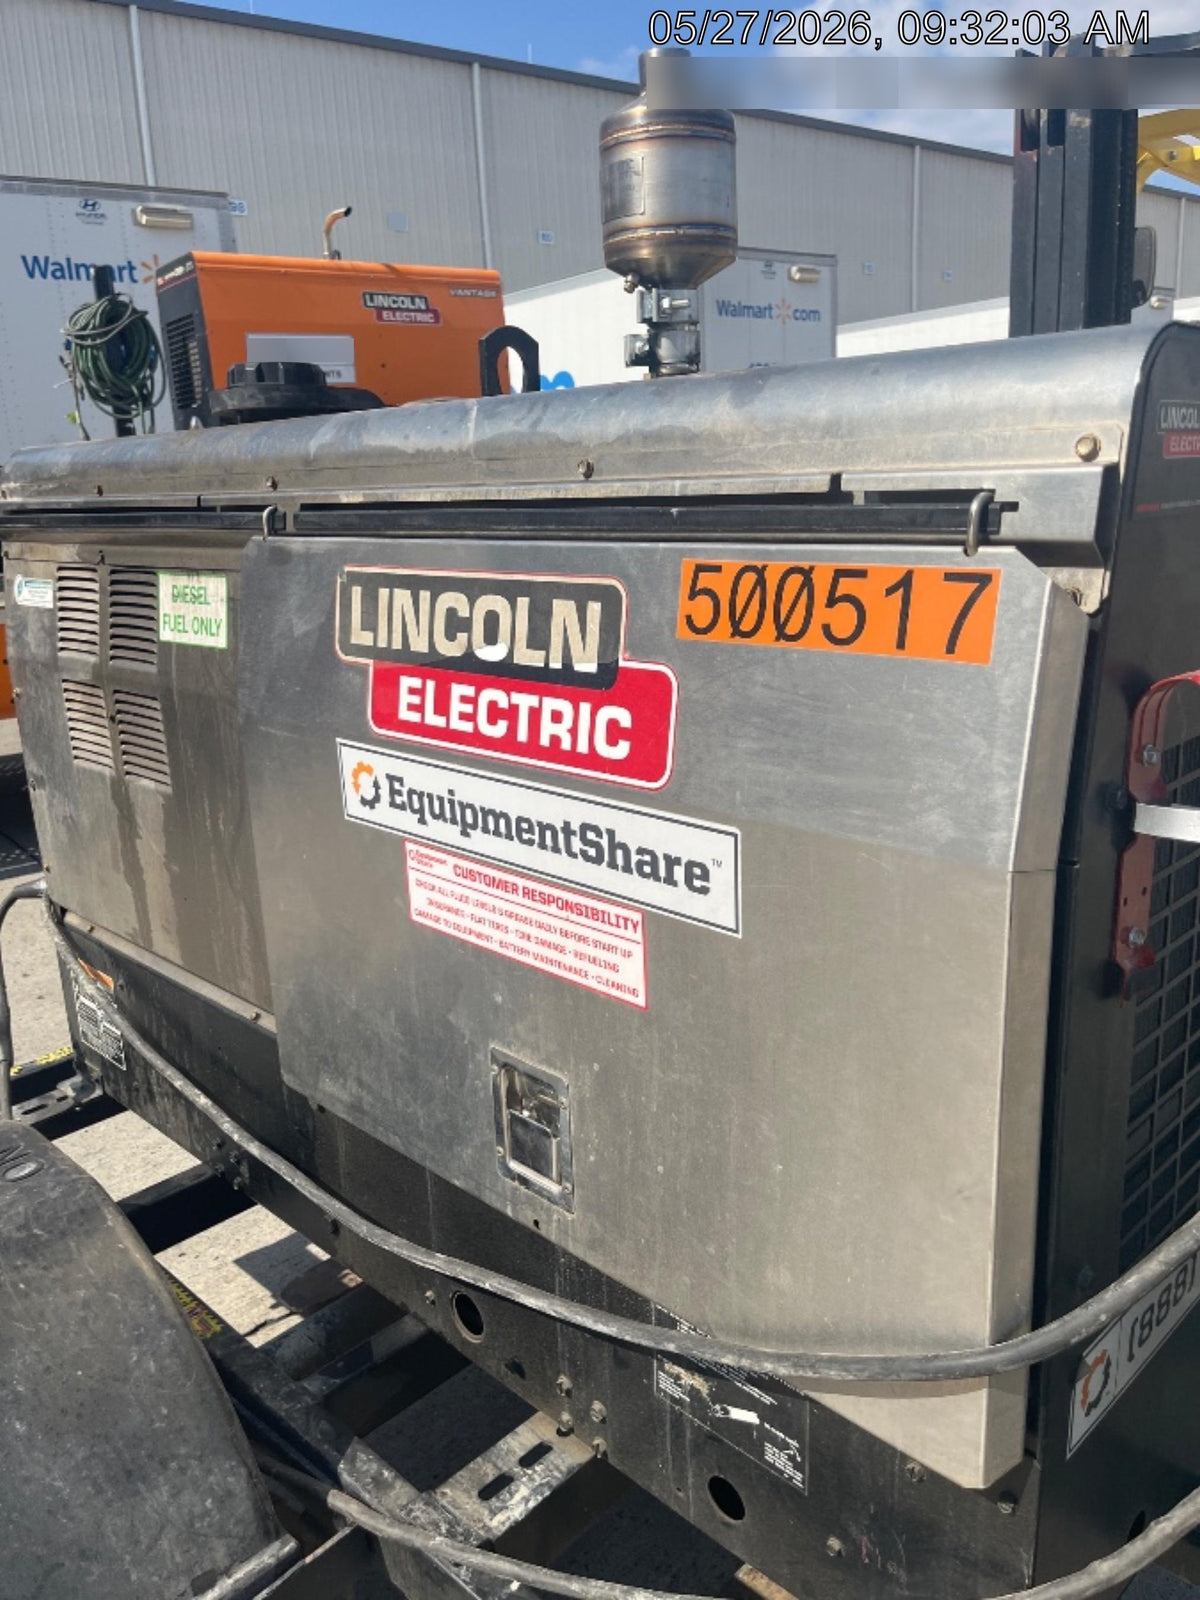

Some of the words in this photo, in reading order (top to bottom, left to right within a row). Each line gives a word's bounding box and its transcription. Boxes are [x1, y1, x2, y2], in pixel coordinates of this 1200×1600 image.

[21, 255, 139, 283] Walmrt
[364, 293, 427, 310] LINCOLN
[716, 300, 773, 319] Walmart
[382, 311, 435, 323] ELECTRIC
[171, 584, 211, 606] DIESEL
[162, 612, 189, 634] FUEL
[191, 616, 223, 637] ONLY
[350, 586, 602, 673] LINCOLN
[398, 675, 632, 760] ELECTRIC
[385, 773, 711, 896] EquipmentShare
[452, 863, 519, 896] CUSTOMER
[521, 884, 640, 934] RESPONSIBILITY
